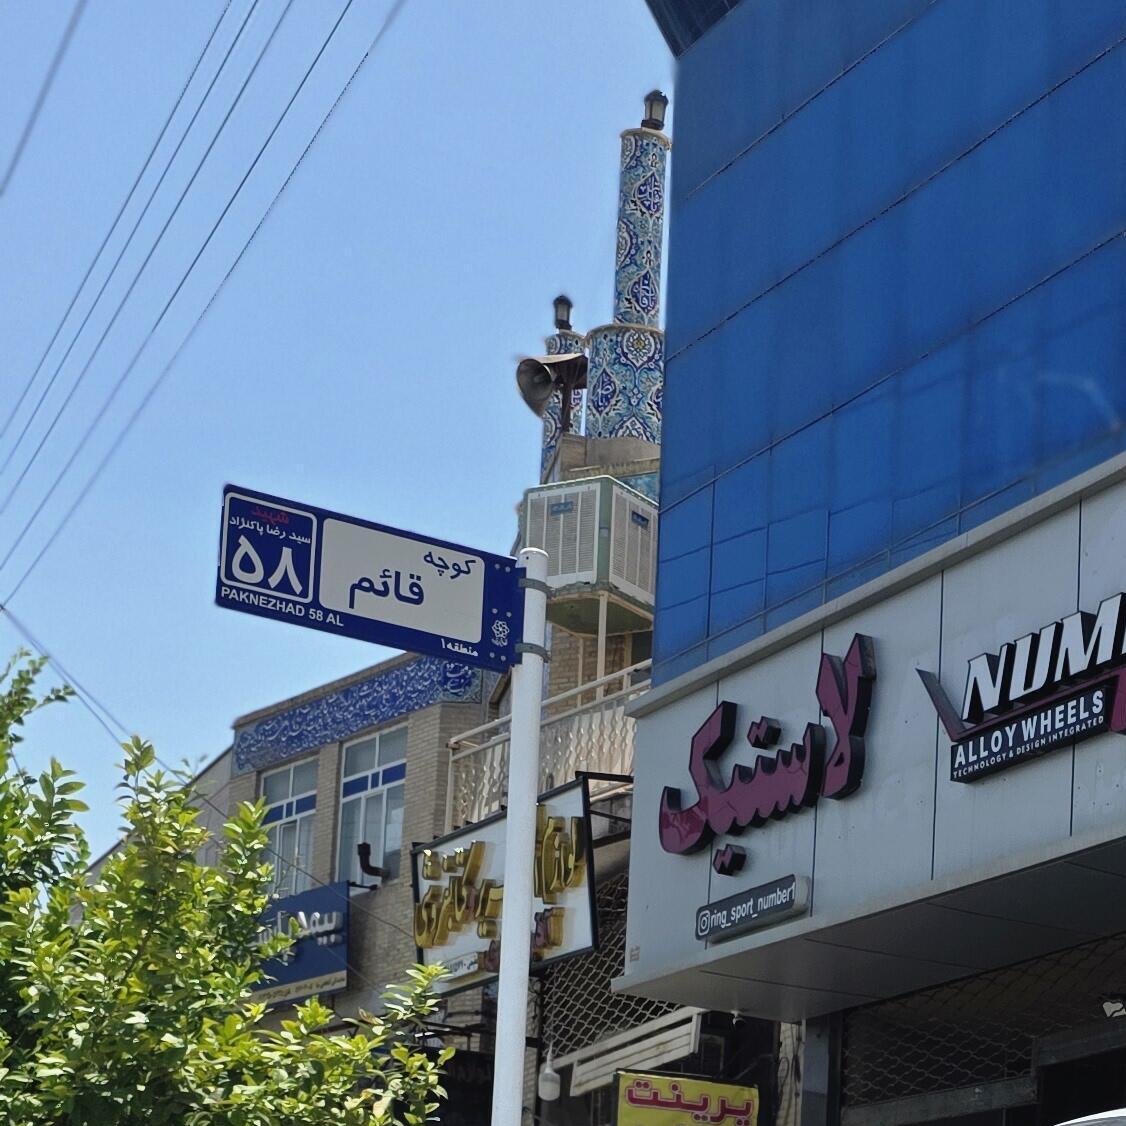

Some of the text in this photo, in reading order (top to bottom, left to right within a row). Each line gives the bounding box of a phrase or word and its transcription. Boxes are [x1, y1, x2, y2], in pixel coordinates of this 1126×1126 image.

[266, 524, 286, 539] رضا
[288, 531, 311, 544] سید
[232, 535, 303, 595] ۵۸
[423, 551, 476, 579] کوچه
[221, 586, 344, 627] PAKNEZHAD 58 AL
[349, 568, 425, 609] قائم
[953, 715, 1104, 779] TECHNOLOGY & DESIGN INTEGRATED
[954, 690, 1104, 768] ALLOY WHEELS
[659, 633, 876, 876] لاستیک
[710, 882, 796, 928] ring_sport_number1
